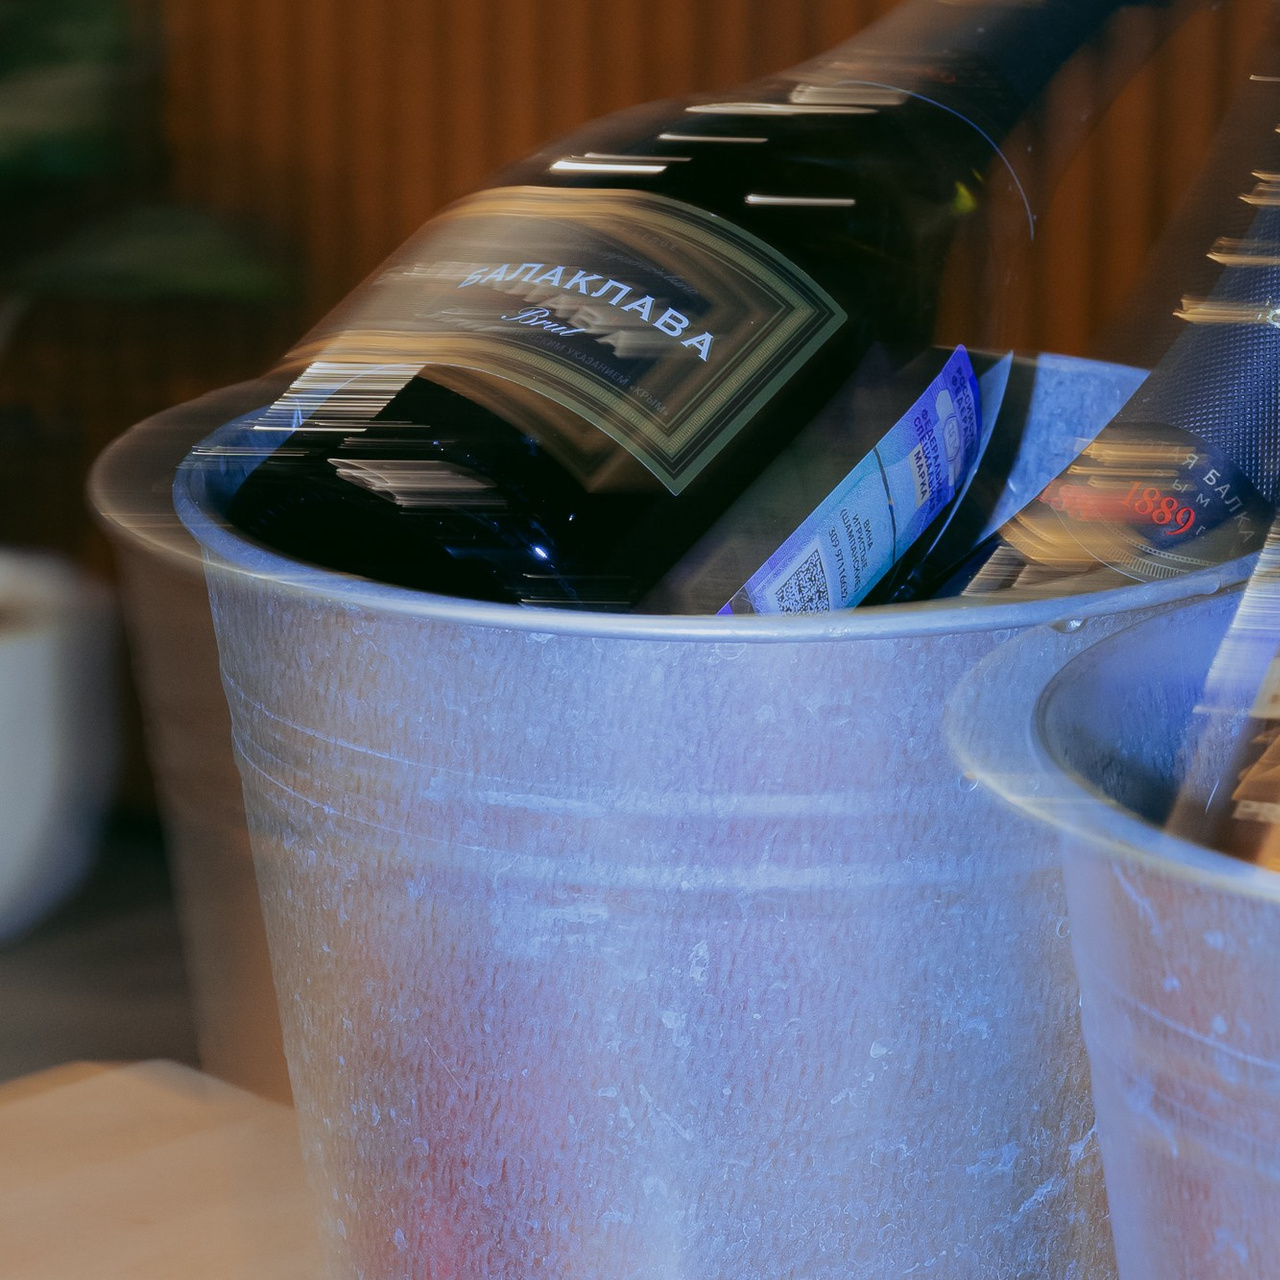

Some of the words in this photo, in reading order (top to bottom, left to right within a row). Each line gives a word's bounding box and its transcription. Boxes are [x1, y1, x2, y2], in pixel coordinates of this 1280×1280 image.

[457, 262, 717, 363] БАЛАКЛАВА
[500, 306, 587, 337] Brut
[567, 347, 630, 386] УКАЗАНИЕМ
[914, 450, 929, 500] МАРКА
[1120, 481, 1197, 536] 1889
[1202, 468, 1256, 543] БАЛКА
[828, 526, 840, 548] 309
[840, 508, 861, 593] (ШАМПАНСКИЕ)
[852, 513, 868, 571] ИГРИСТЫЕ
[863, 519, 874, 551] ВИНА
